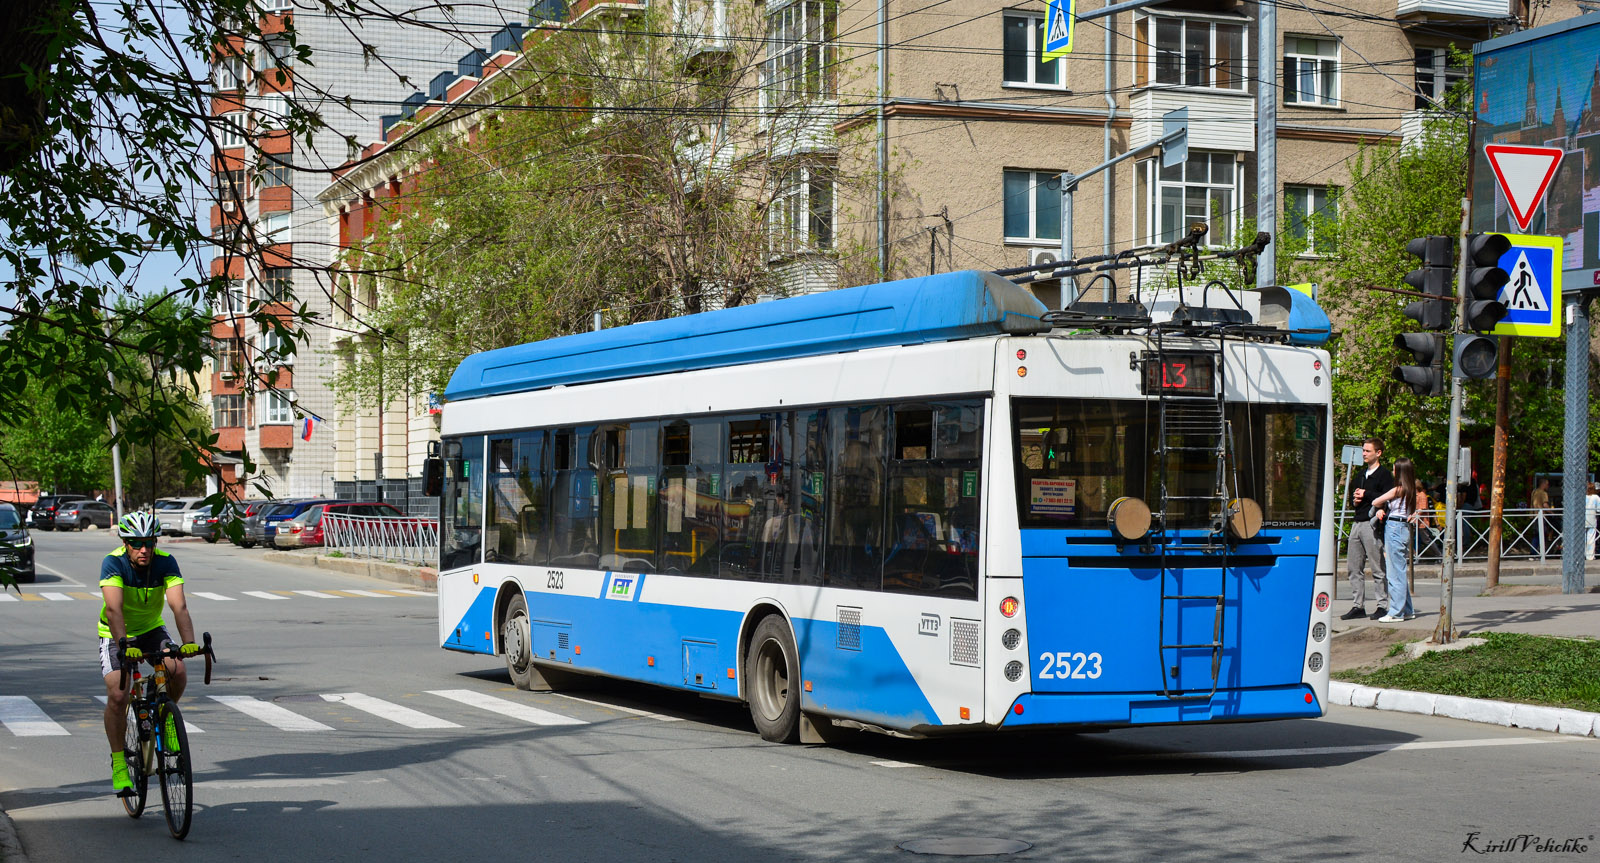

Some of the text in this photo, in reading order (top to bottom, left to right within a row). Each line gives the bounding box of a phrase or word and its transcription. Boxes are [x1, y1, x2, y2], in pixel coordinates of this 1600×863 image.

[547, 570, 564, 590] 2523
[921, 618, 939, 631] УТТЗ
[1038, 651, 1103, 680] 2523
